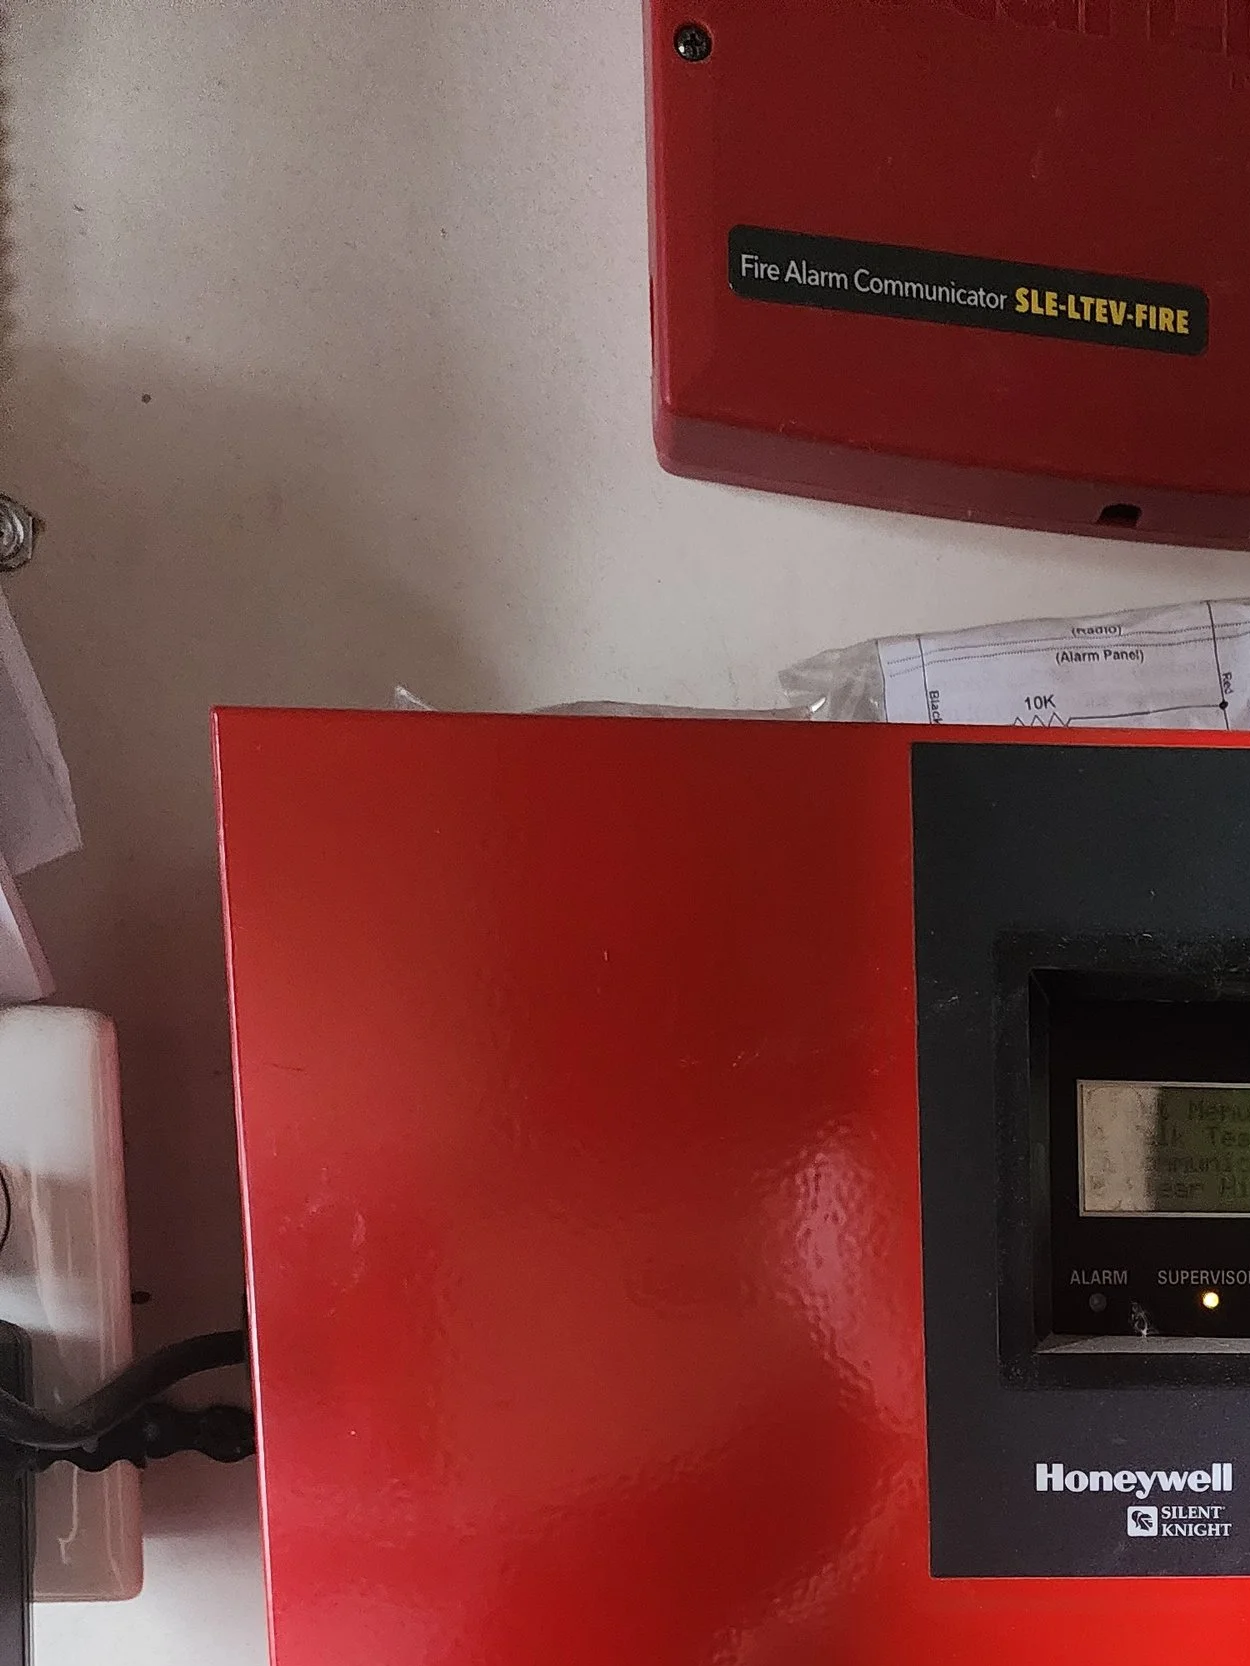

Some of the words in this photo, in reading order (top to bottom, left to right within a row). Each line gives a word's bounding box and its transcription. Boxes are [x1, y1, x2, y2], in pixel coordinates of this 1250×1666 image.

[740, 254, 780, 281] Fire
[784, 260, 848, 291] Alarm
[853, 268, 1007, 310] Communicator
[1015, 287, 1190, 335] SLE-LTEV-FIRE
[1056, 650, 1100, 666] (Alarm
[1103, 649, 1144, 664] Panel)
[1222, 672, 1234, 695] Red
[1024, 694, 1057, 711] 10K
[1070, 1269, 1129, 1286] ALARM
[1035, 1462, 1233, 1499] Honeywell
[1161, 1505, 1223, 1520] SILENT
[1161, 1522, 1232, 1537] KNIGHT
